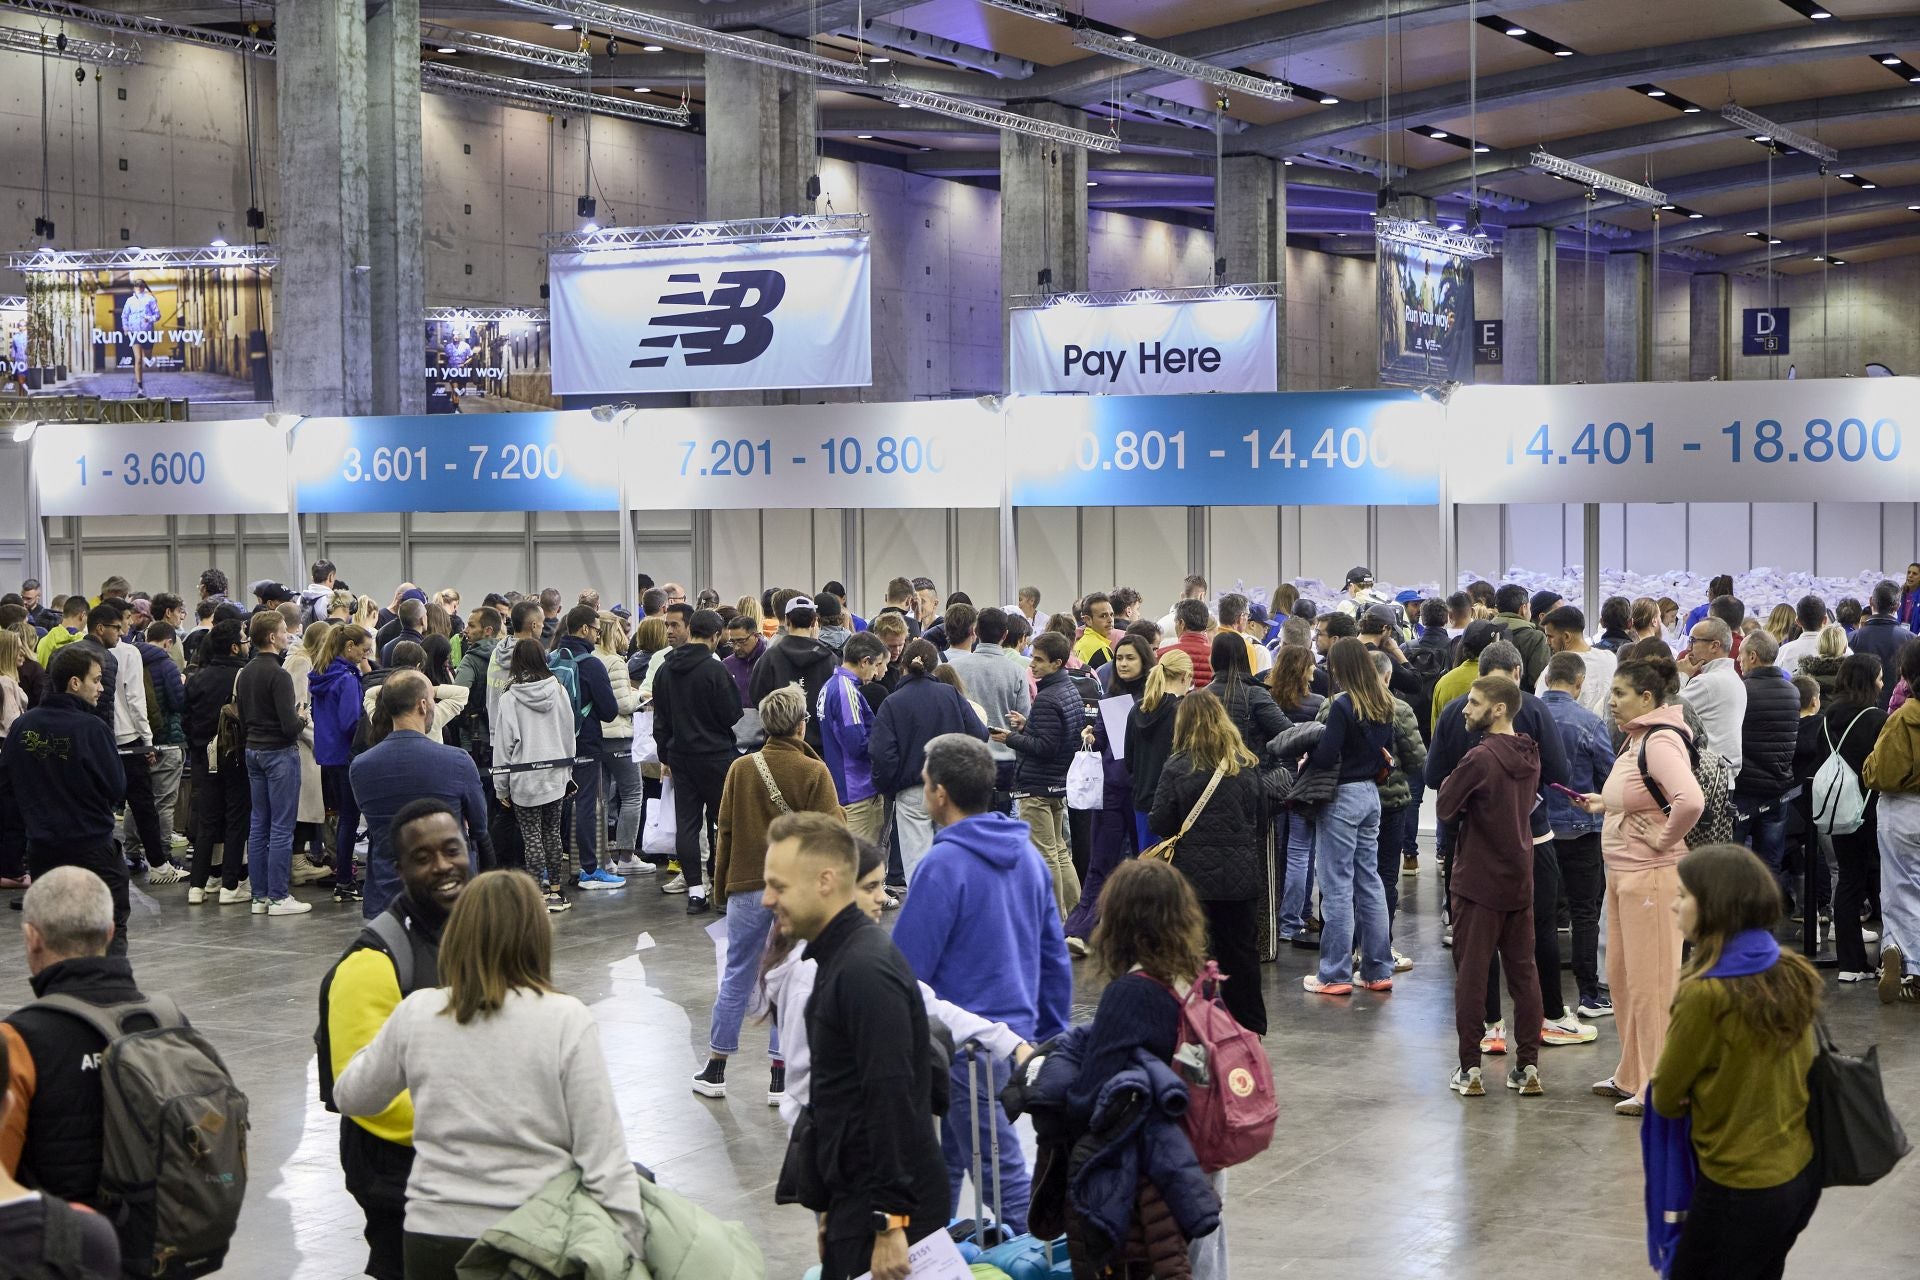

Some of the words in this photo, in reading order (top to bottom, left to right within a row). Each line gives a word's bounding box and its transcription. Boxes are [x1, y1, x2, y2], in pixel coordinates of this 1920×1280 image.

[1405, 305, 1418, 322] Run
[1419, 310, 1434, 327] your
[1435, 312, 1450, 331] way.
[1756, 312, 1776, 334] D
[92, 328, 123, 344] Run
[127, 331, 165, 347] your
[168, 330, 206, 346] way.
[1483, 324, 1495, 345] E
[1767, 340, 1775, 348] 5
[1064, 344, 1127, 383] Pay
[1139, 341, 1221, 374] Here
[1490, 349, 1497, 358] 5
[441, 367, 472, 380] your
[1057, 430, 1185, 471] 0.801
[1722, 417, 1902, 463] 18.800
[75, 455, 88, 486] 1
[122, 451, 206, 486] 3.600
[343, 446, 428, 483] 3.601
[469, 442, 565, 482] 7.200
[677, 439, 771, 477] 7.201
